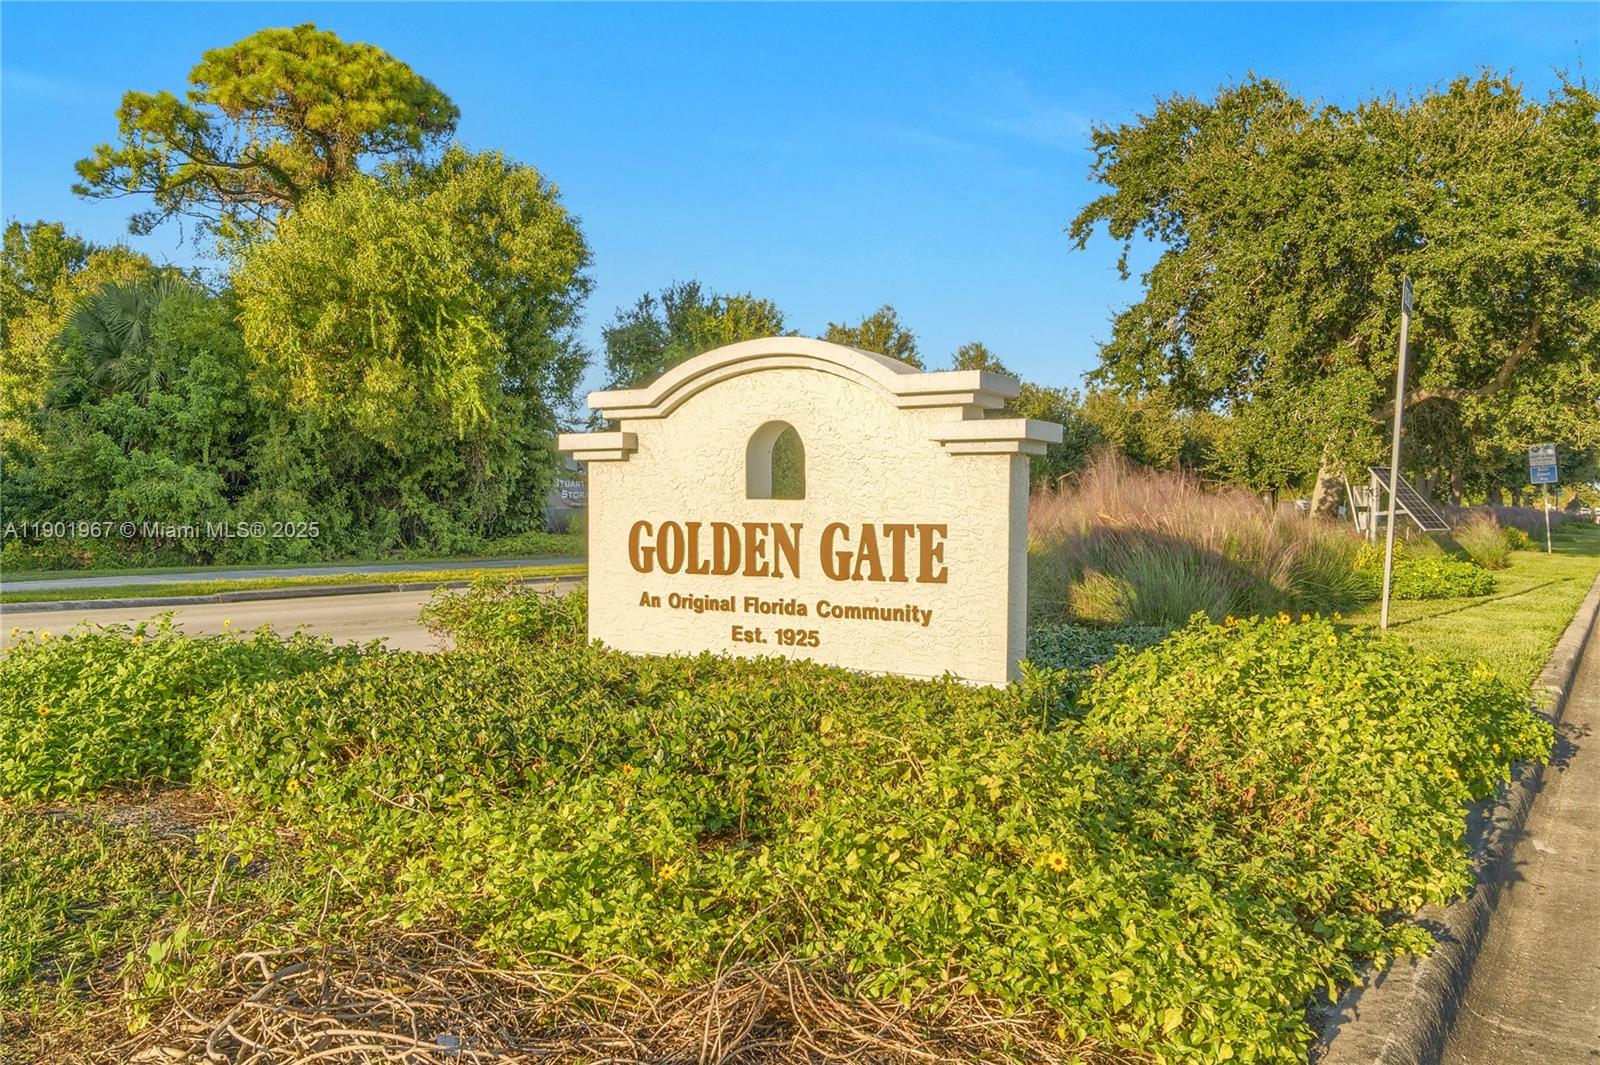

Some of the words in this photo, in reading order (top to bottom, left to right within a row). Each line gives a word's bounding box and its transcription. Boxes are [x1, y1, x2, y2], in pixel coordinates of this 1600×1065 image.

[628, 520, 803, 579] GOLDEN
[820, 521, 949, 584] GATE
[639, 591, 661, 608] An
[668, 592, 736, 613] Original
[744, 596, 808, 617] Florida
[816, 599, 933, 627] Community
[731, 625, 768, 644] Est.
[774, 628, 821, 648] 1925
